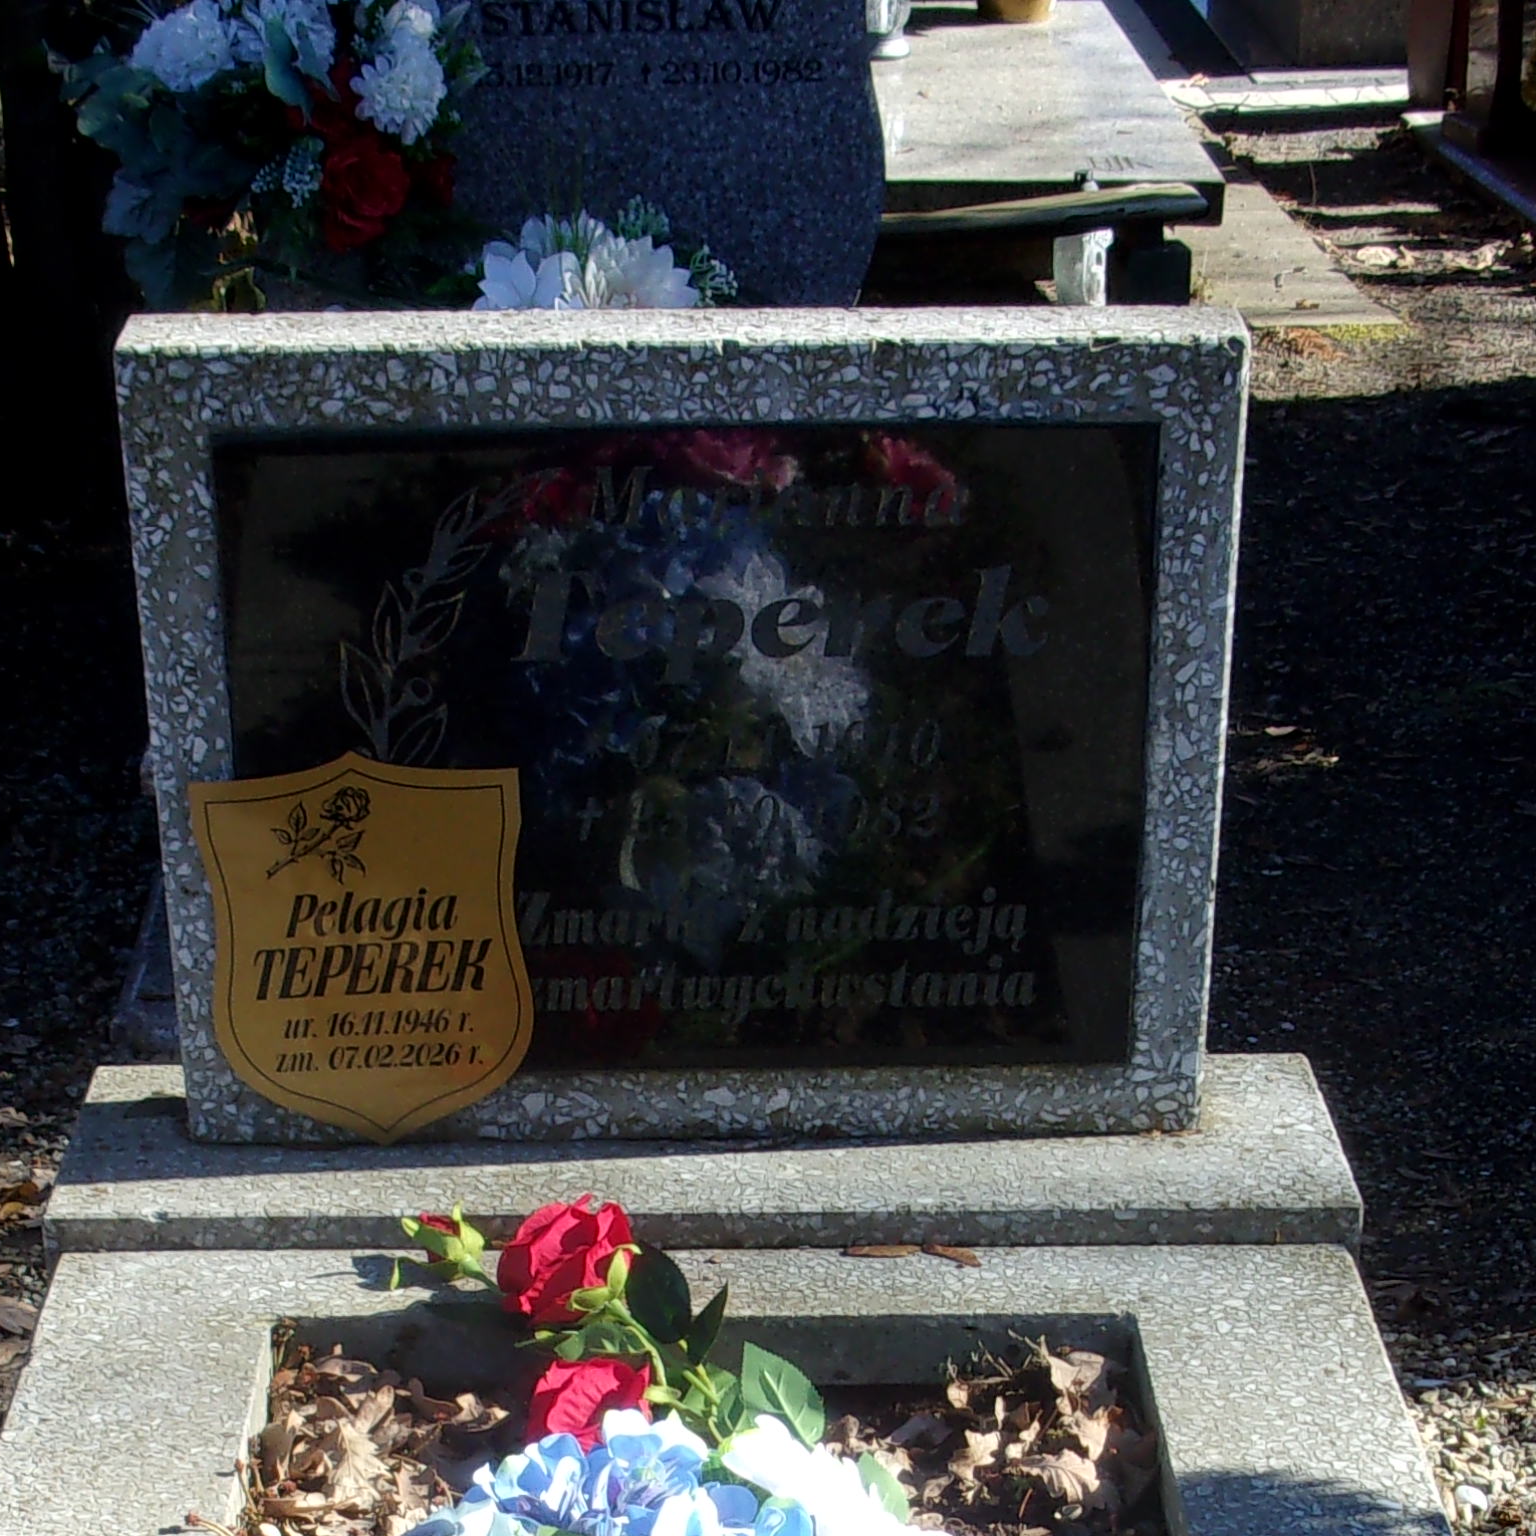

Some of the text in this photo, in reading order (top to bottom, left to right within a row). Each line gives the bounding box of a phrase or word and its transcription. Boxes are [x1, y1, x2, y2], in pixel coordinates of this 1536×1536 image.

[507, 562, 1051, 687] Teperek
[286, 888, 458, 940] Pelagia
[784, 886, 1027, 955] nadzieją
[254, 938, 492, 1001] TEPEREK
[284, 1009, 474, 1039] ur. 16.11.1946 r.
[276, 1042, 485, 1073] zm. 07.02.2026 r.
